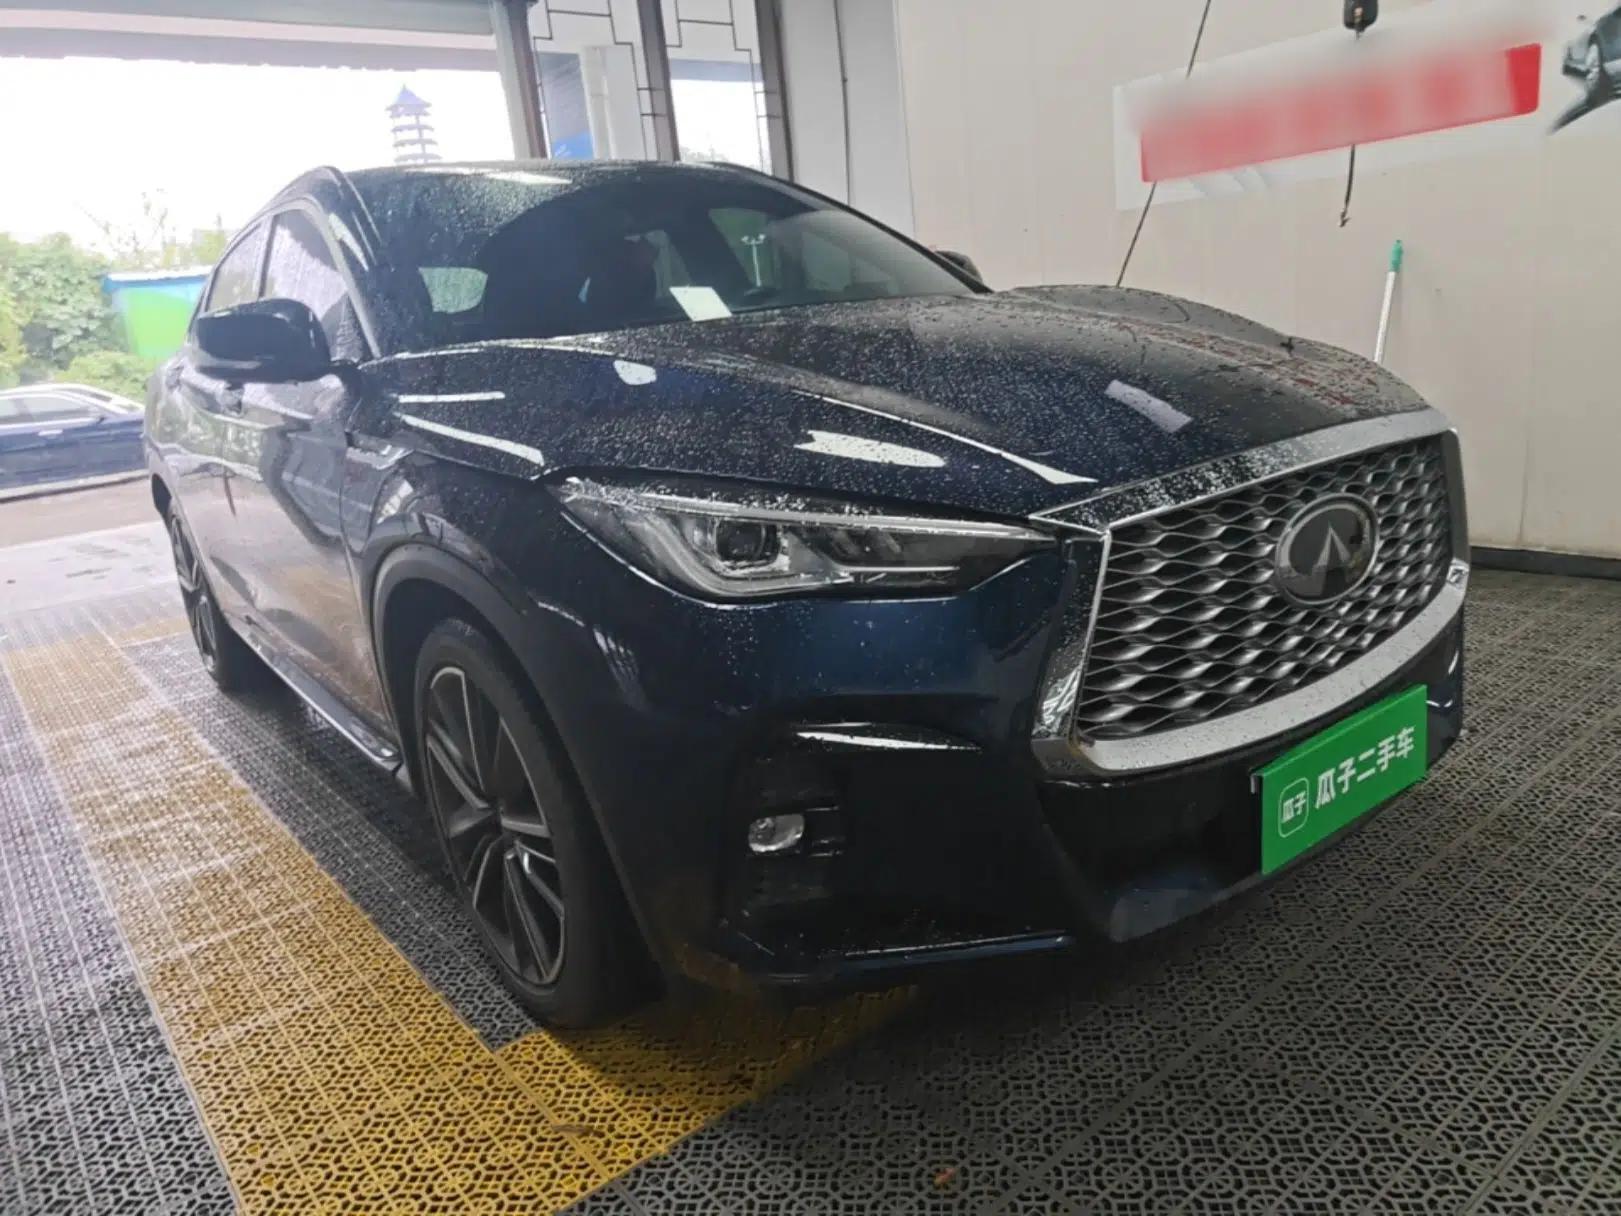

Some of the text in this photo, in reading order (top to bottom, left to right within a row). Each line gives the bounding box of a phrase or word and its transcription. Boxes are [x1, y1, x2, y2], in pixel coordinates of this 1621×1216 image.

[1315, 726, 1415, 809] 瓜子二手车
[1281, 791, 1307, 824] 瓜子
